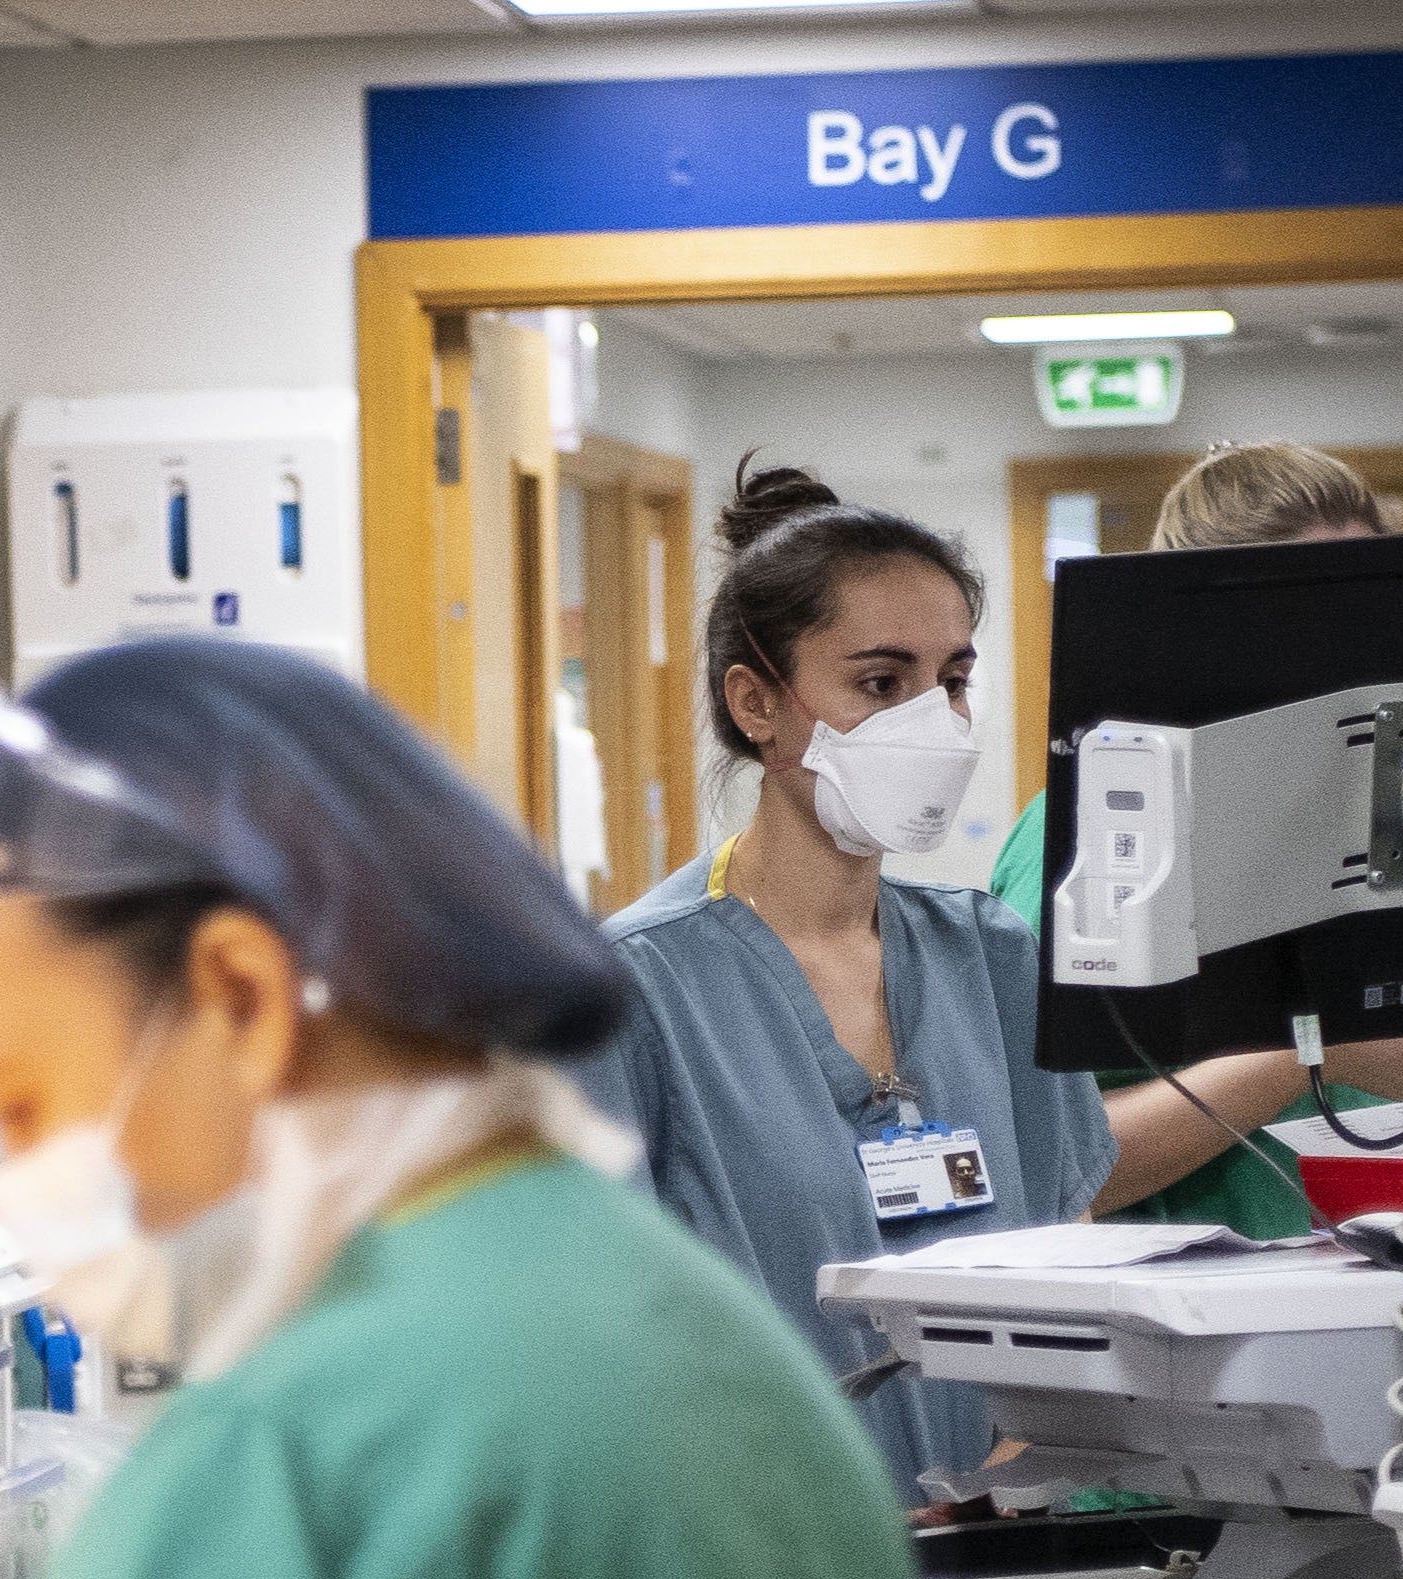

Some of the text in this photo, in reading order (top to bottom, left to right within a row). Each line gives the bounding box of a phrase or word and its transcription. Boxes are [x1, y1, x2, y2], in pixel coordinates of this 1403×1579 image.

[807, 104, 1062, 201] Bay G
[1071, 958, 1118, 972] code
